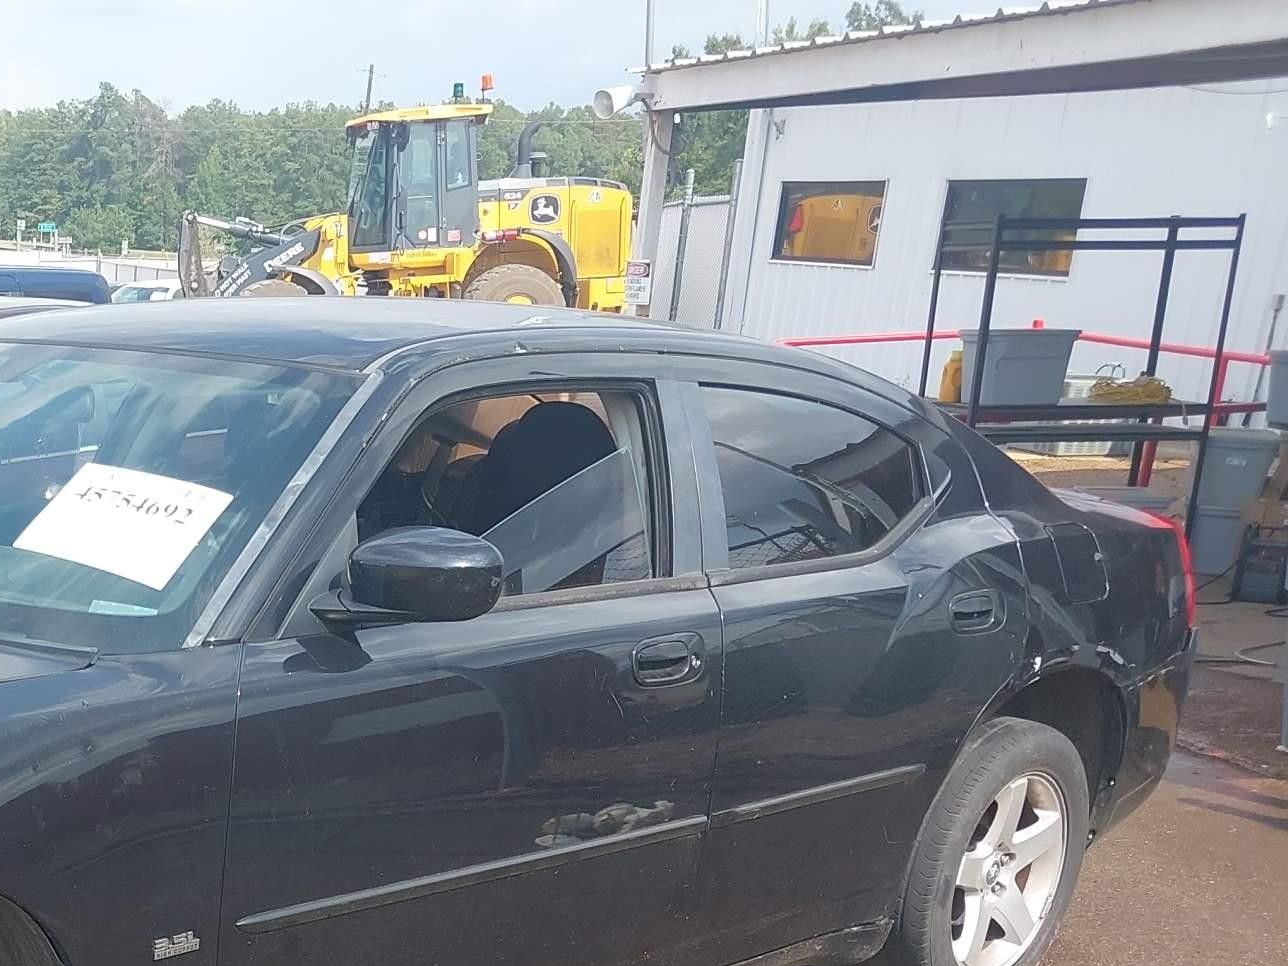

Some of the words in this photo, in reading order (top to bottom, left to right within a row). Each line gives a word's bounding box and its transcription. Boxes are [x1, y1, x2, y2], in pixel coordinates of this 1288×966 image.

[263, 242, 305, 273] DEERE
[220, 277, 233, 292] NOT
[232, 262, 249, 279] WALK
[154, 931, 200, 950] 3.5L
